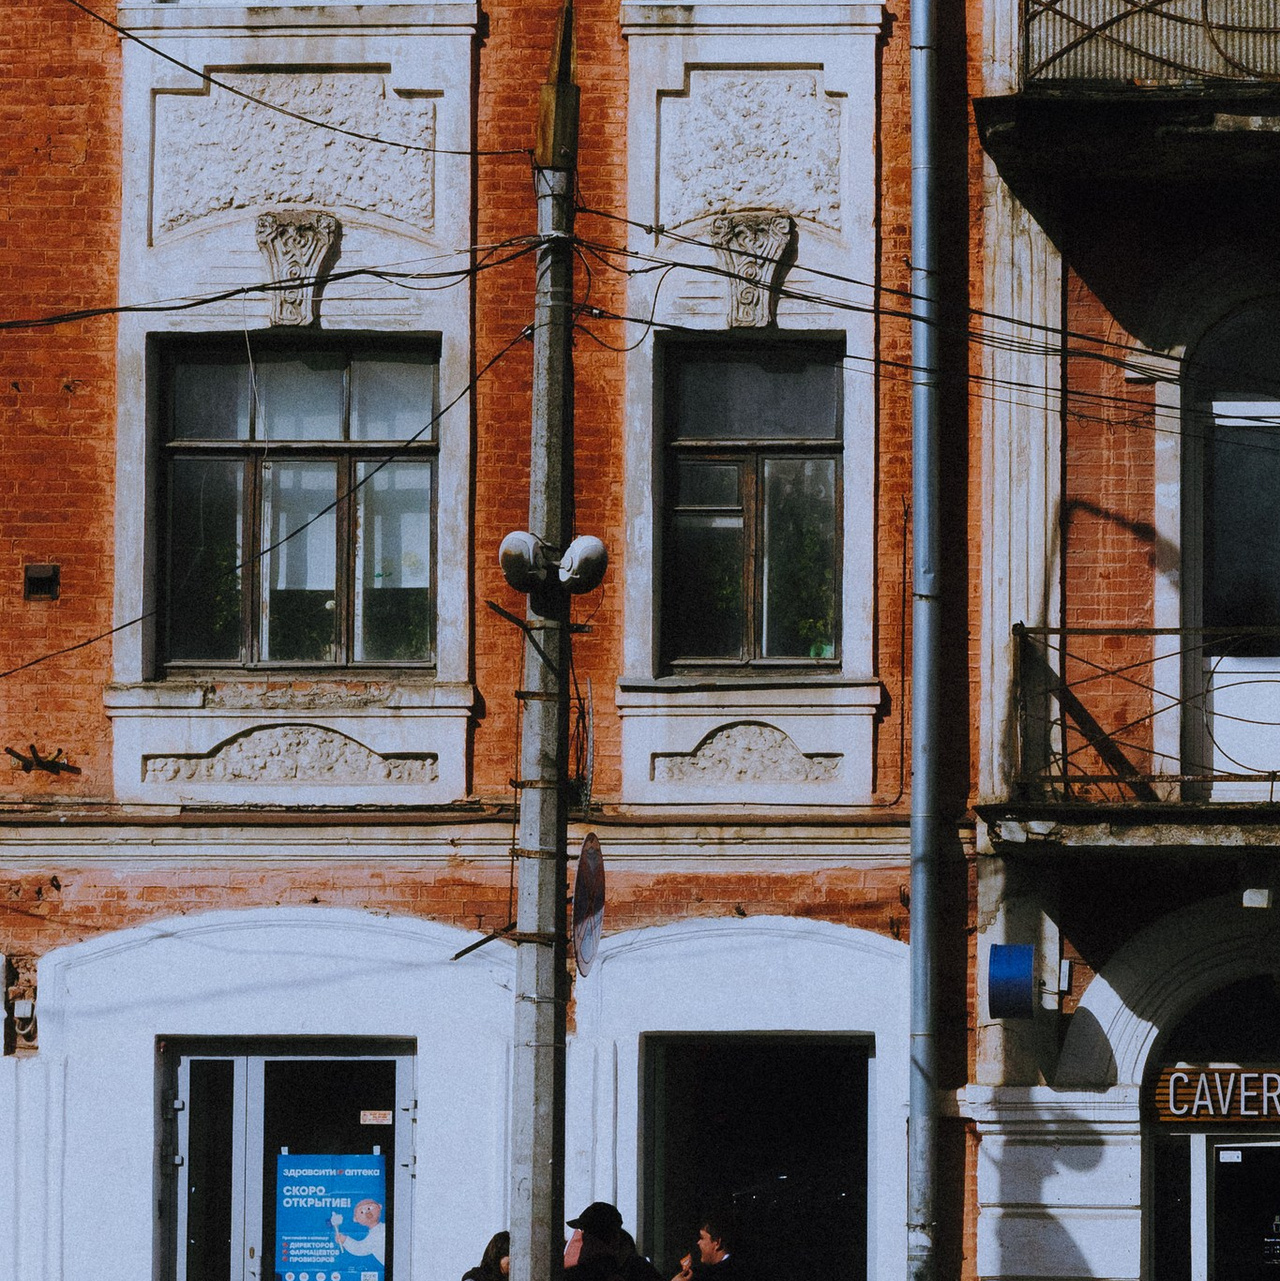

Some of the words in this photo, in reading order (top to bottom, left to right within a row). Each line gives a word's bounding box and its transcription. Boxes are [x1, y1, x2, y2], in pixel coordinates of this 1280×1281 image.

[283, 1168, 336, 1178] здравсити
[283, 1185, 326, 1196] СКОРО
[283, 1197, 351, 1208] ОТКРЫТИЕ!
